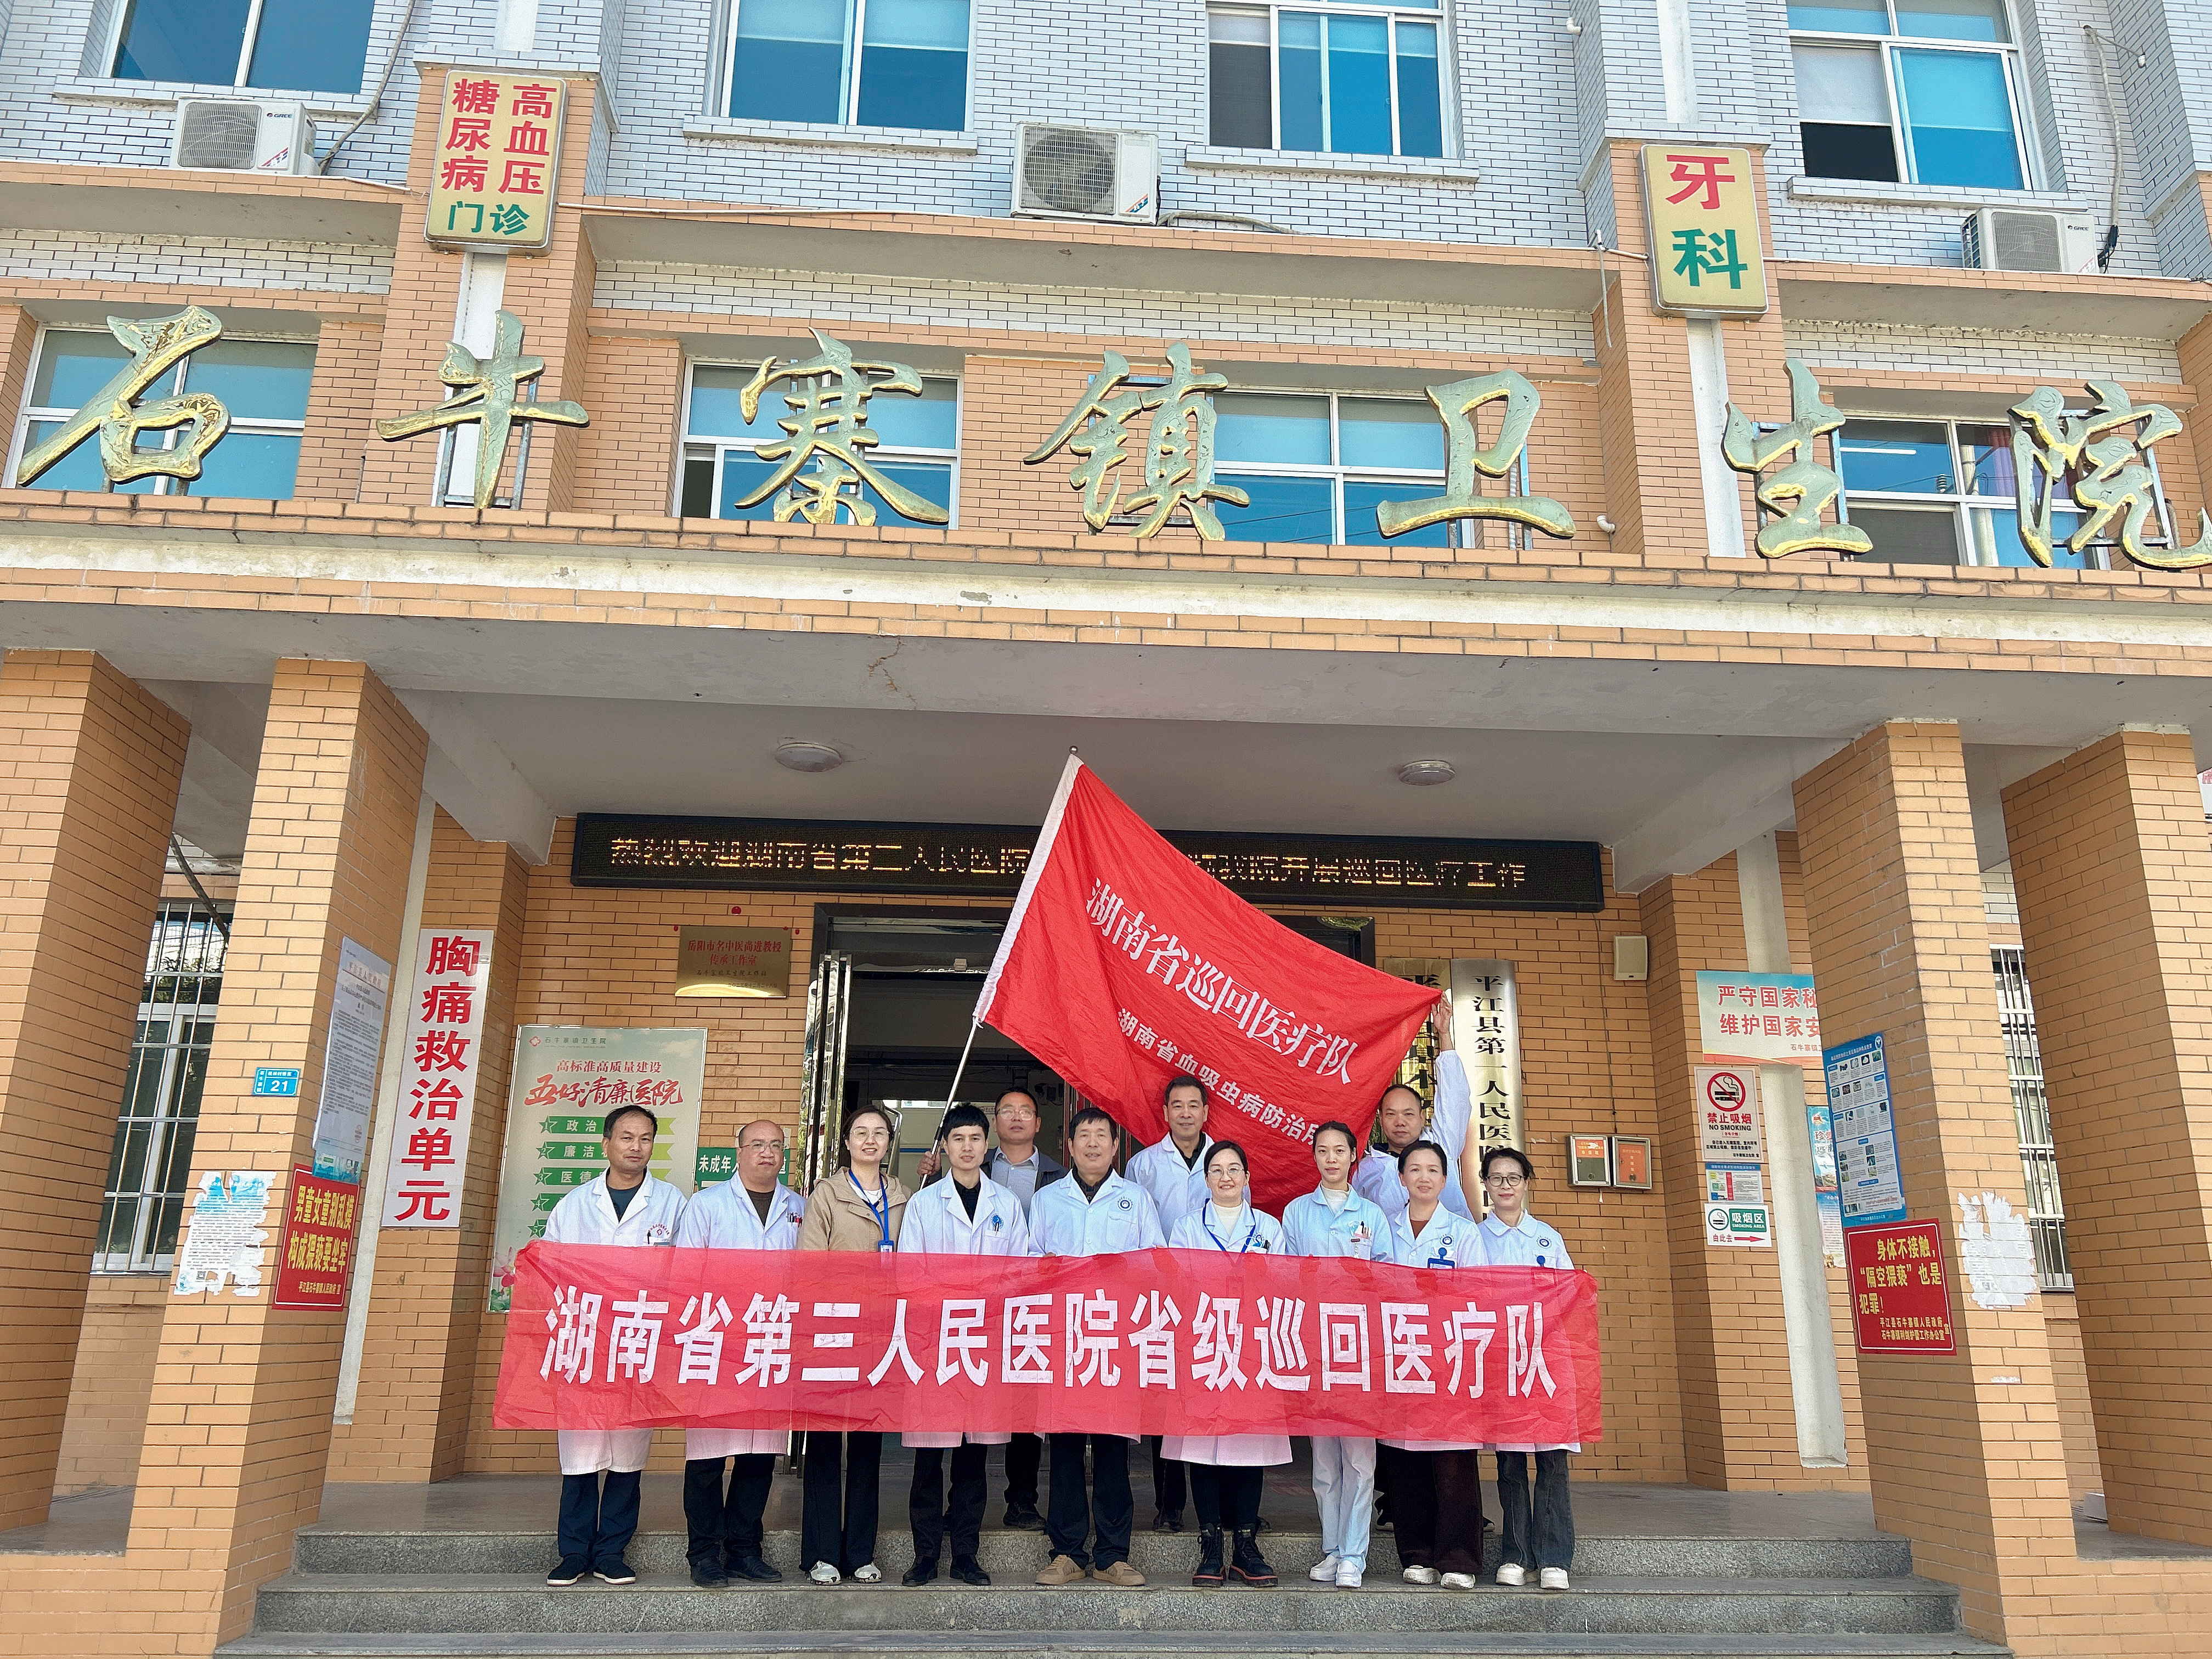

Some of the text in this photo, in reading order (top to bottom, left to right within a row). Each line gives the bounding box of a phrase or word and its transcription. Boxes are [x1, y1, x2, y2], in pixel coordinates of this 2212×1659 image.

[441, 78, 500, 193] 糖尿病
[498, 83, 557, 196] 高血压
[448, 201, 530, 235] 门诊
[1665, 155, 1748, 289] 牙科
[709, 953, 757, 966] 传承工作室
[1086, 877, 1358, 1085] 湖南省巡回医疗队
[1719, 1013, 1821, 1038] 维护国家安
[394, 935, 481, 1221] 胸痛救治单元
[556, 1060, 662, 1073] 高标准高质量建设
[1471, 975, 1513, 1162] 平江县第一人民医
[270, 1080, 288, 1092] 21
[524, 1074, 684, 1108] 五好清廉医院
[566, 1120, 597, 1132] 政治
[1707, 1113, 1752, 1124] 禁止吸烟
[563, 1145, 607, 1158] 廉洁
[294, 1185, 355, 1230] 男童女童别乱摸
[1731, 1212, 1764, 1223] 吸烟区
[287, 1230, 348, 1274] 构成猥亵要坐牢
[1713, 1234, 1733, 1242] 由此去
[540, 1284, 1558, 1400] 湖南省第三人民医院省级巡回医疗队
